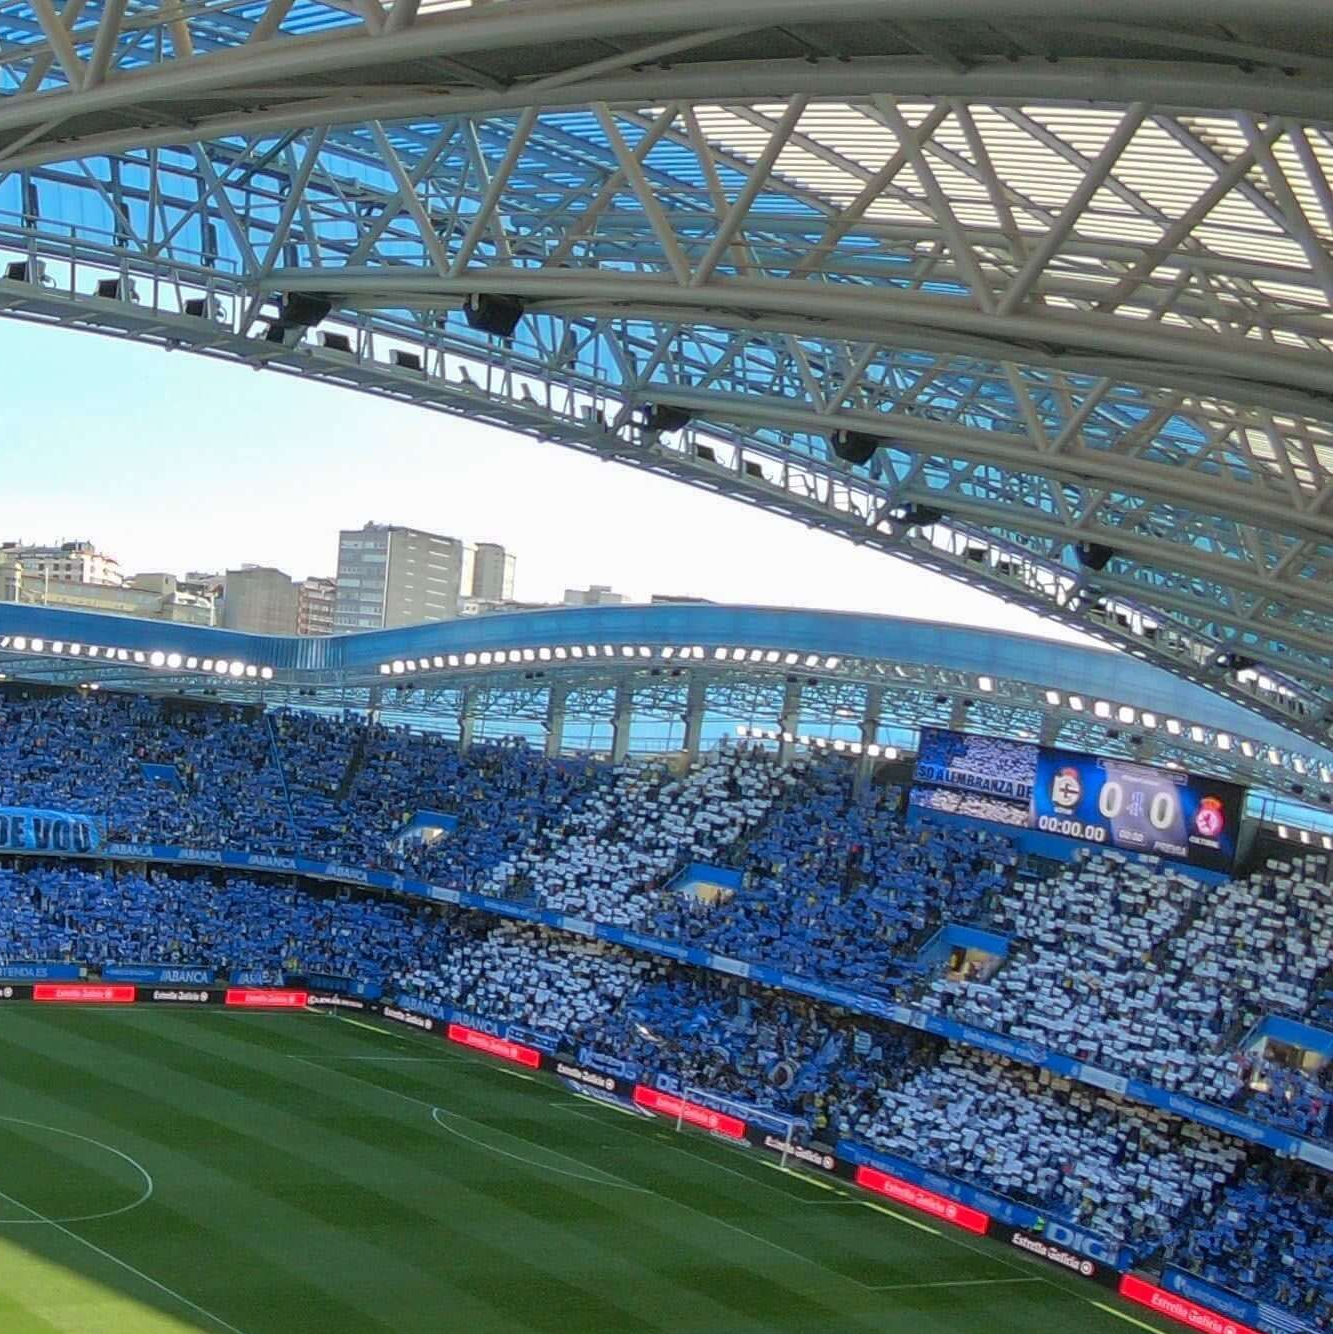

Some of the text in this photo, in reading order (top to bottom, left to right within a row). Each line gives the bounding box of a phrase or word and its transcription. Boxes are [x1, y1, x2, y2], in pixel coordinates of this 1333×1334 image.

[944, 770, 1013, 797] LEMBRANZA
[1099, 782, 1123, 818] 0
[1150, 792, 1173, 829] 0
[33, 819, 90, 852] VOU
[1039, 815, 1105, 842] 00:00.00
